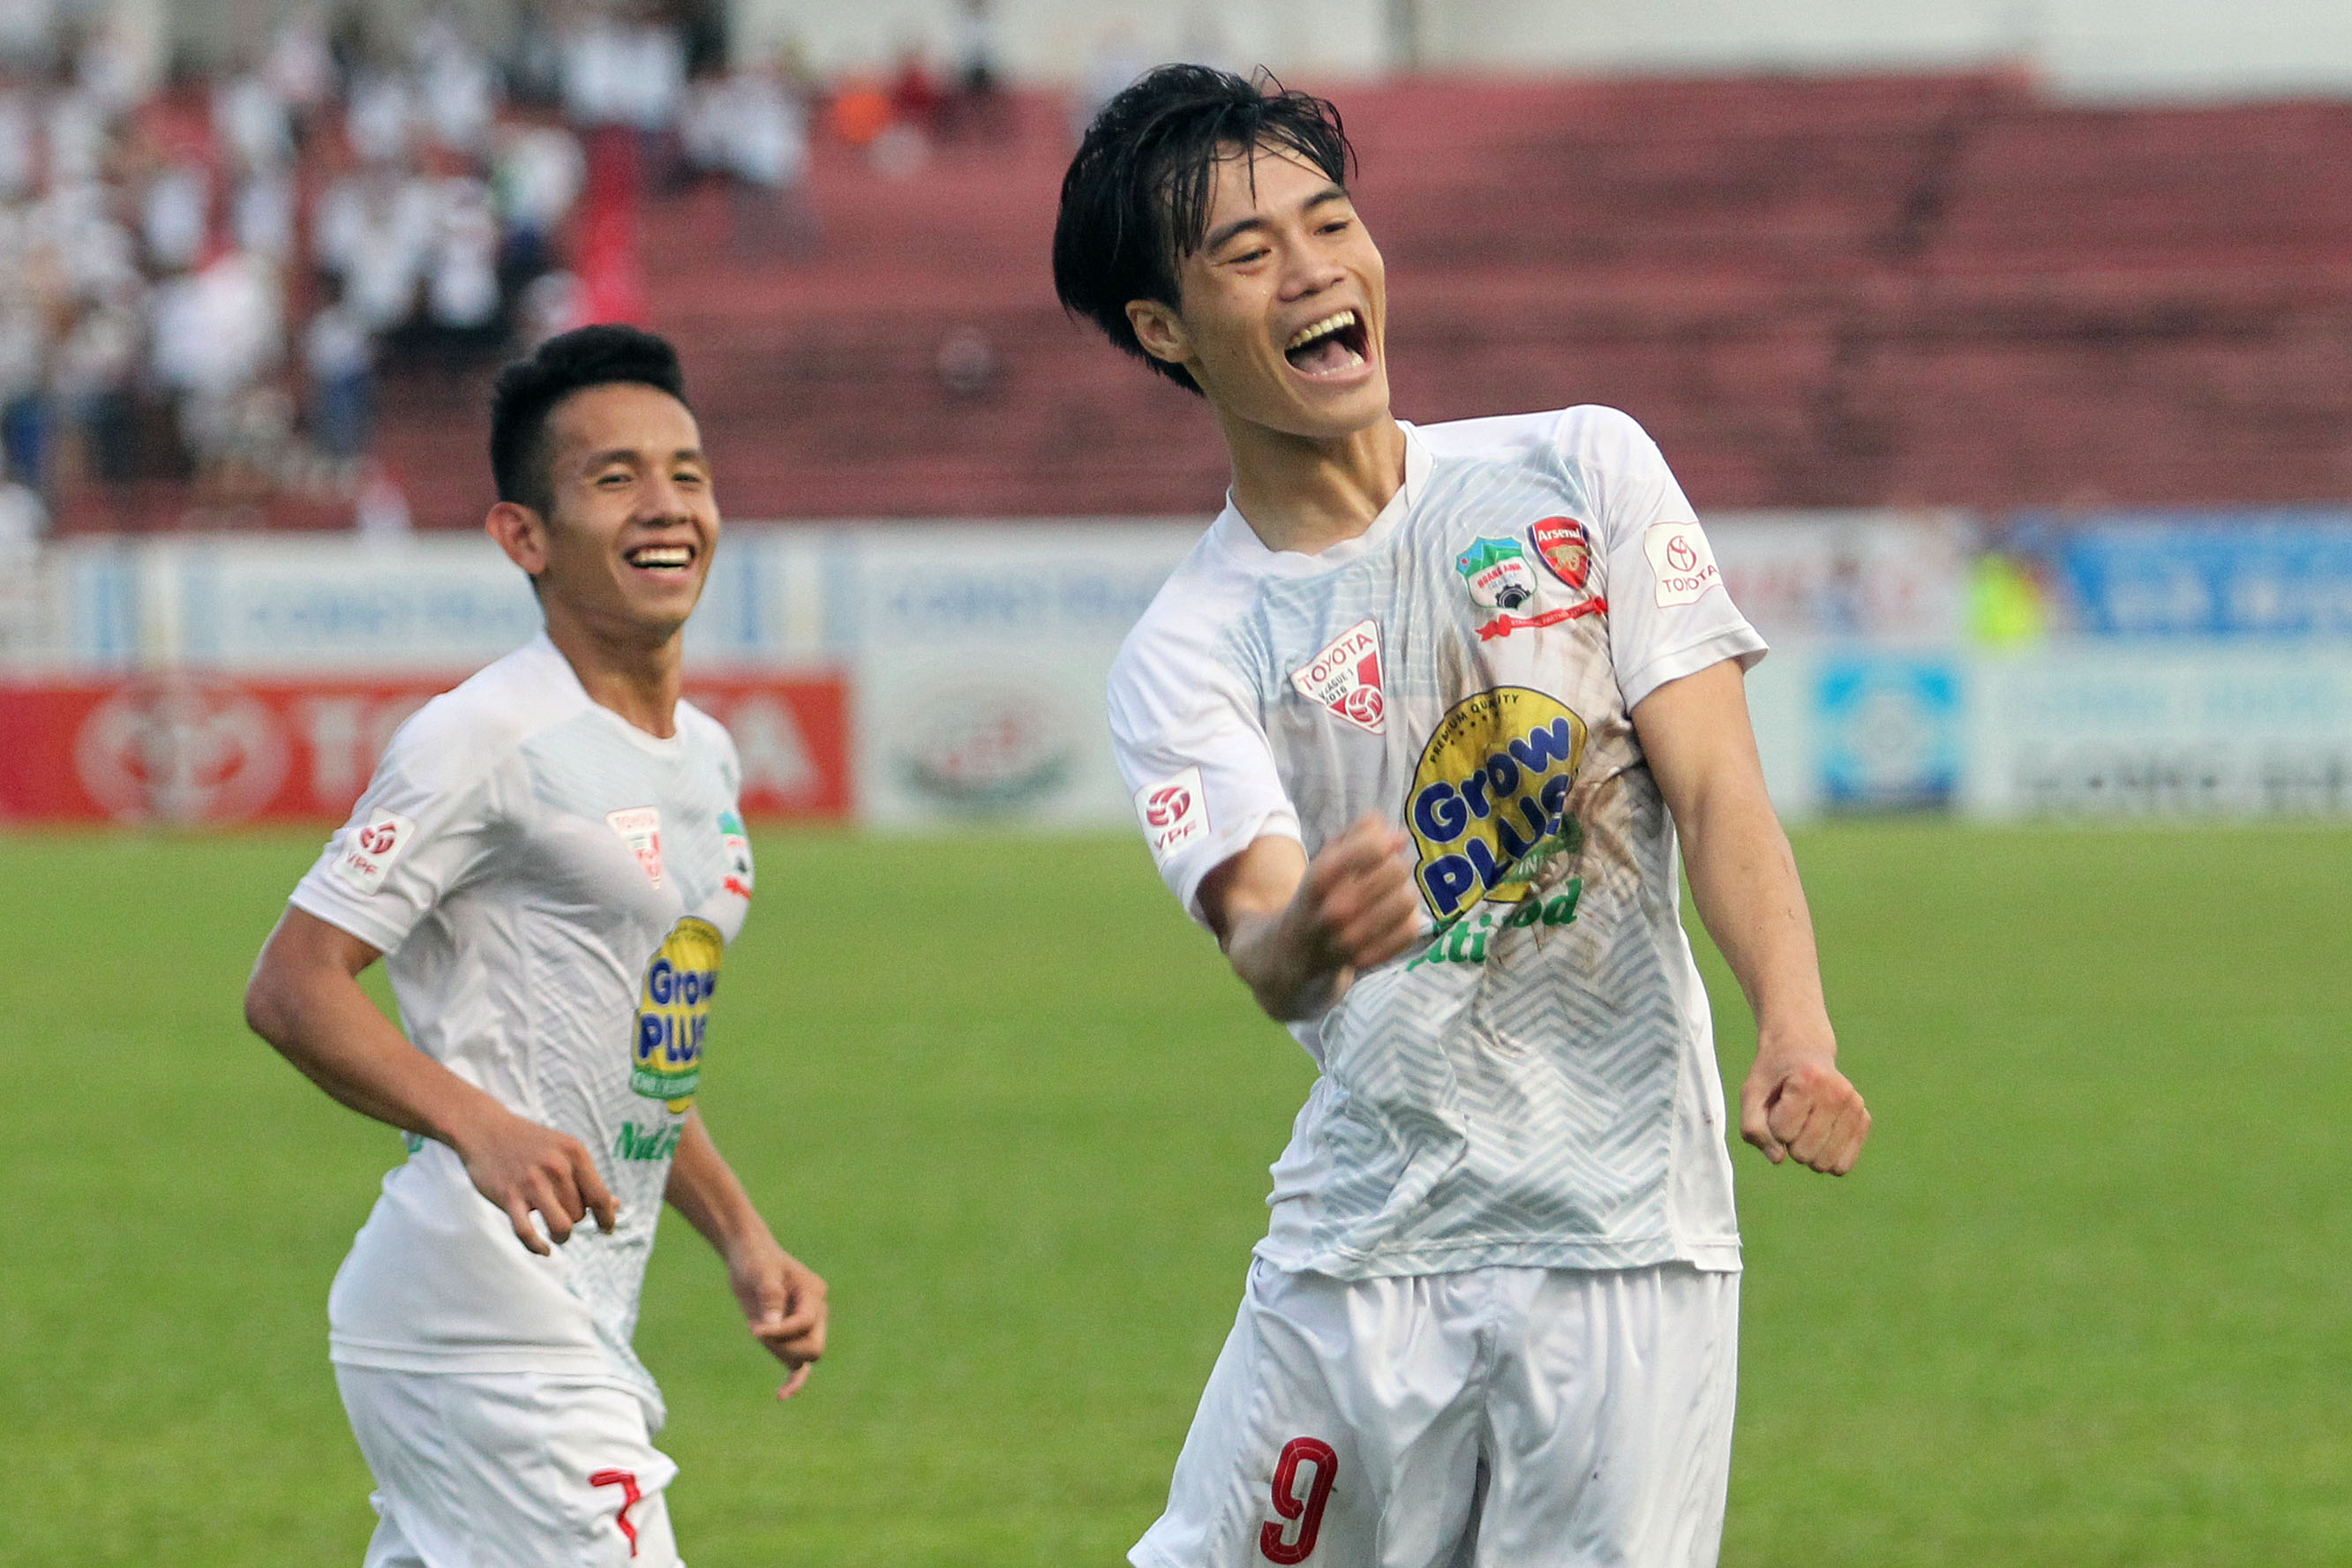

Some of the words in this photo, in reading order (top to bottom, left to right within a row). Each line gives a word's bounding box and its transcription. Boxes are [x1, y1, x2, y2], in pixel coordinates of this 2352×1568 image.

[1298, 633, 1373, 691] TOYOTA
[1430, 711, 1468, 764] PREMIUM
[1414, 716, 1570, 844] Grow
[1154, 820, 1197, 850] VPF
[589, 1469, 641, 1558] 7
[1260, 1437, 1339, 1565] 9
